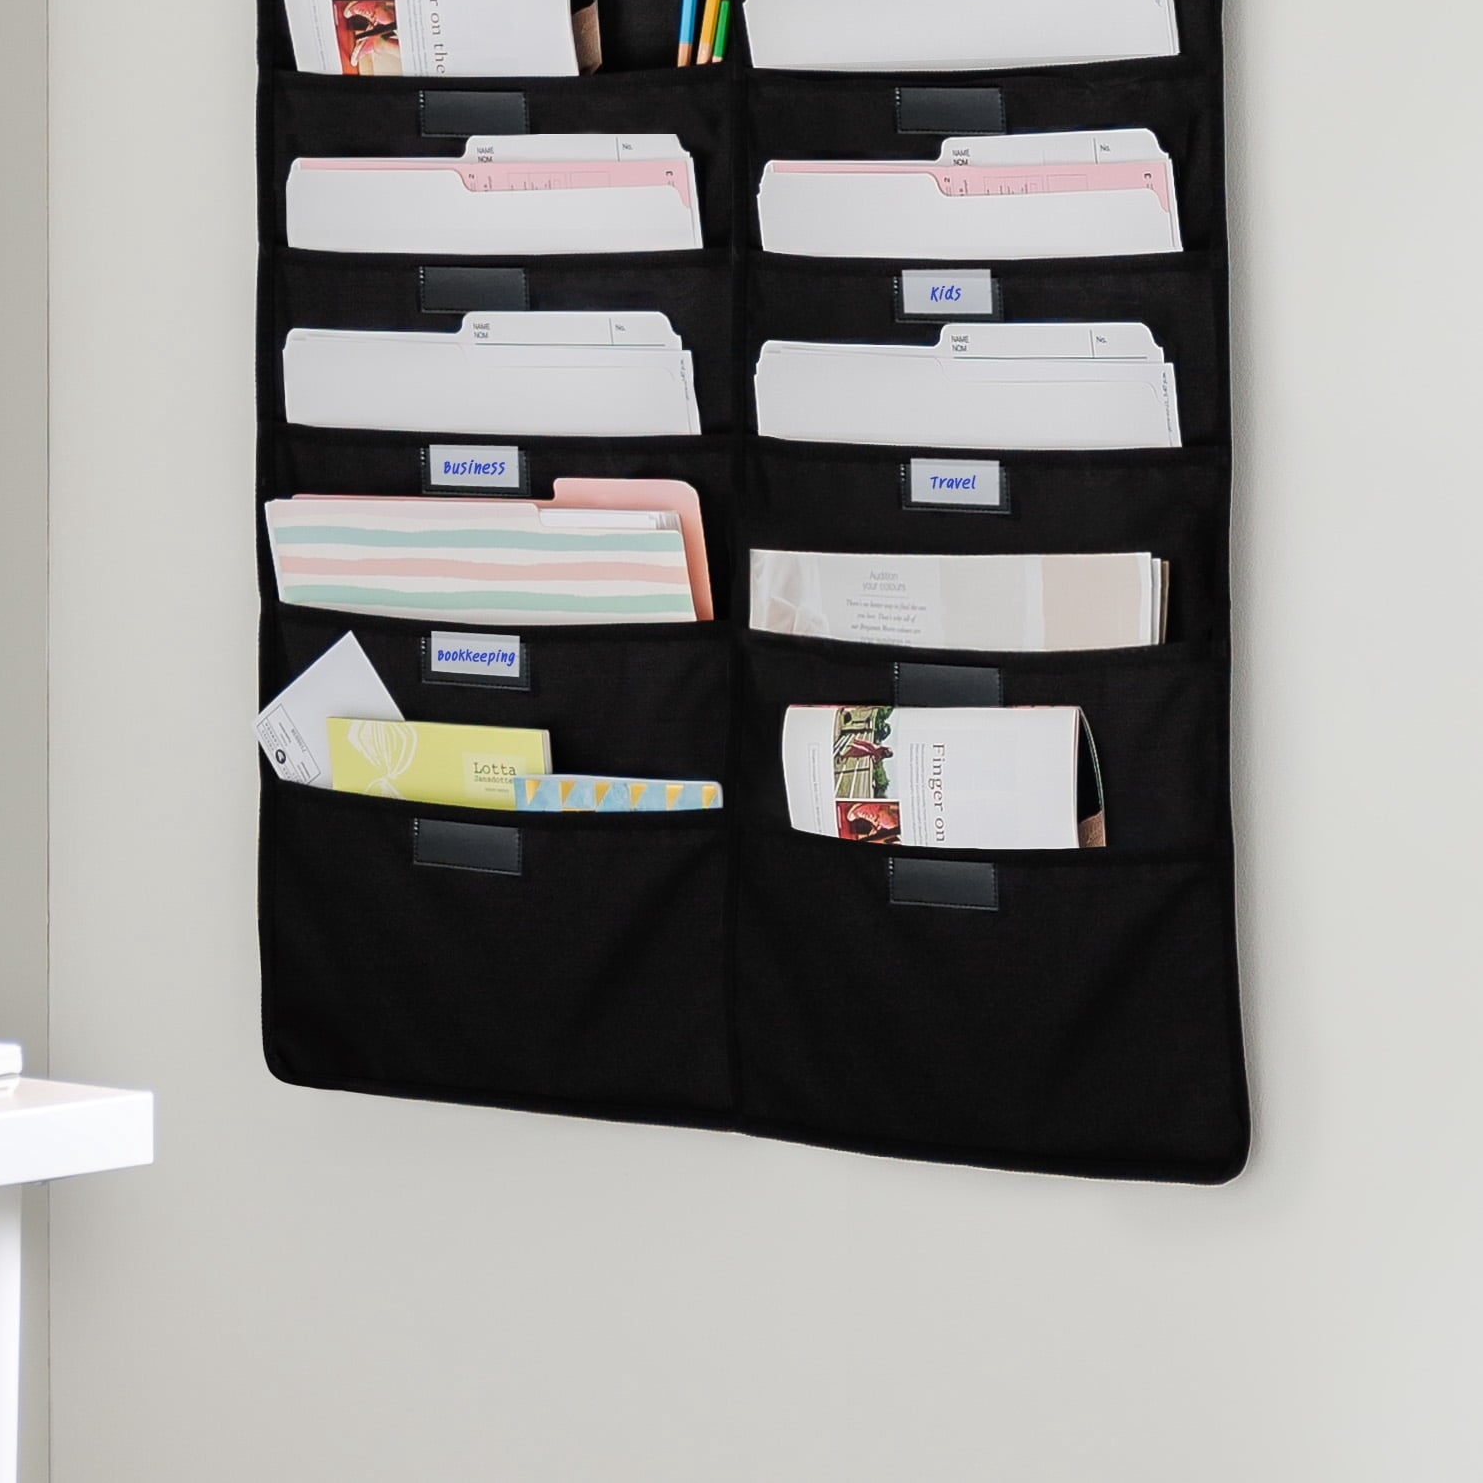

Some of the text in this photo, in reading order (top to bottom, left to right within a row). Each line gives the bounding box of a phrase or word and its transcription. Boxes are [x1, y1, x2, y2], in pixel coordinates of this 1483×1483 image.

[430, 12, 441, 36] on
[434, 43, 449, 74] the
[930, 285, 962, 302] Kids
[443, 459, 506, 475] Business
[930, 474, 976, 489] Travel
[437, 648, 516, 667] Bookkeeping
[473, 762, 517, 776] Lotta
[473, 775, 513, 784] Jansdotte
[928, 743, 946, 842] Finger on
